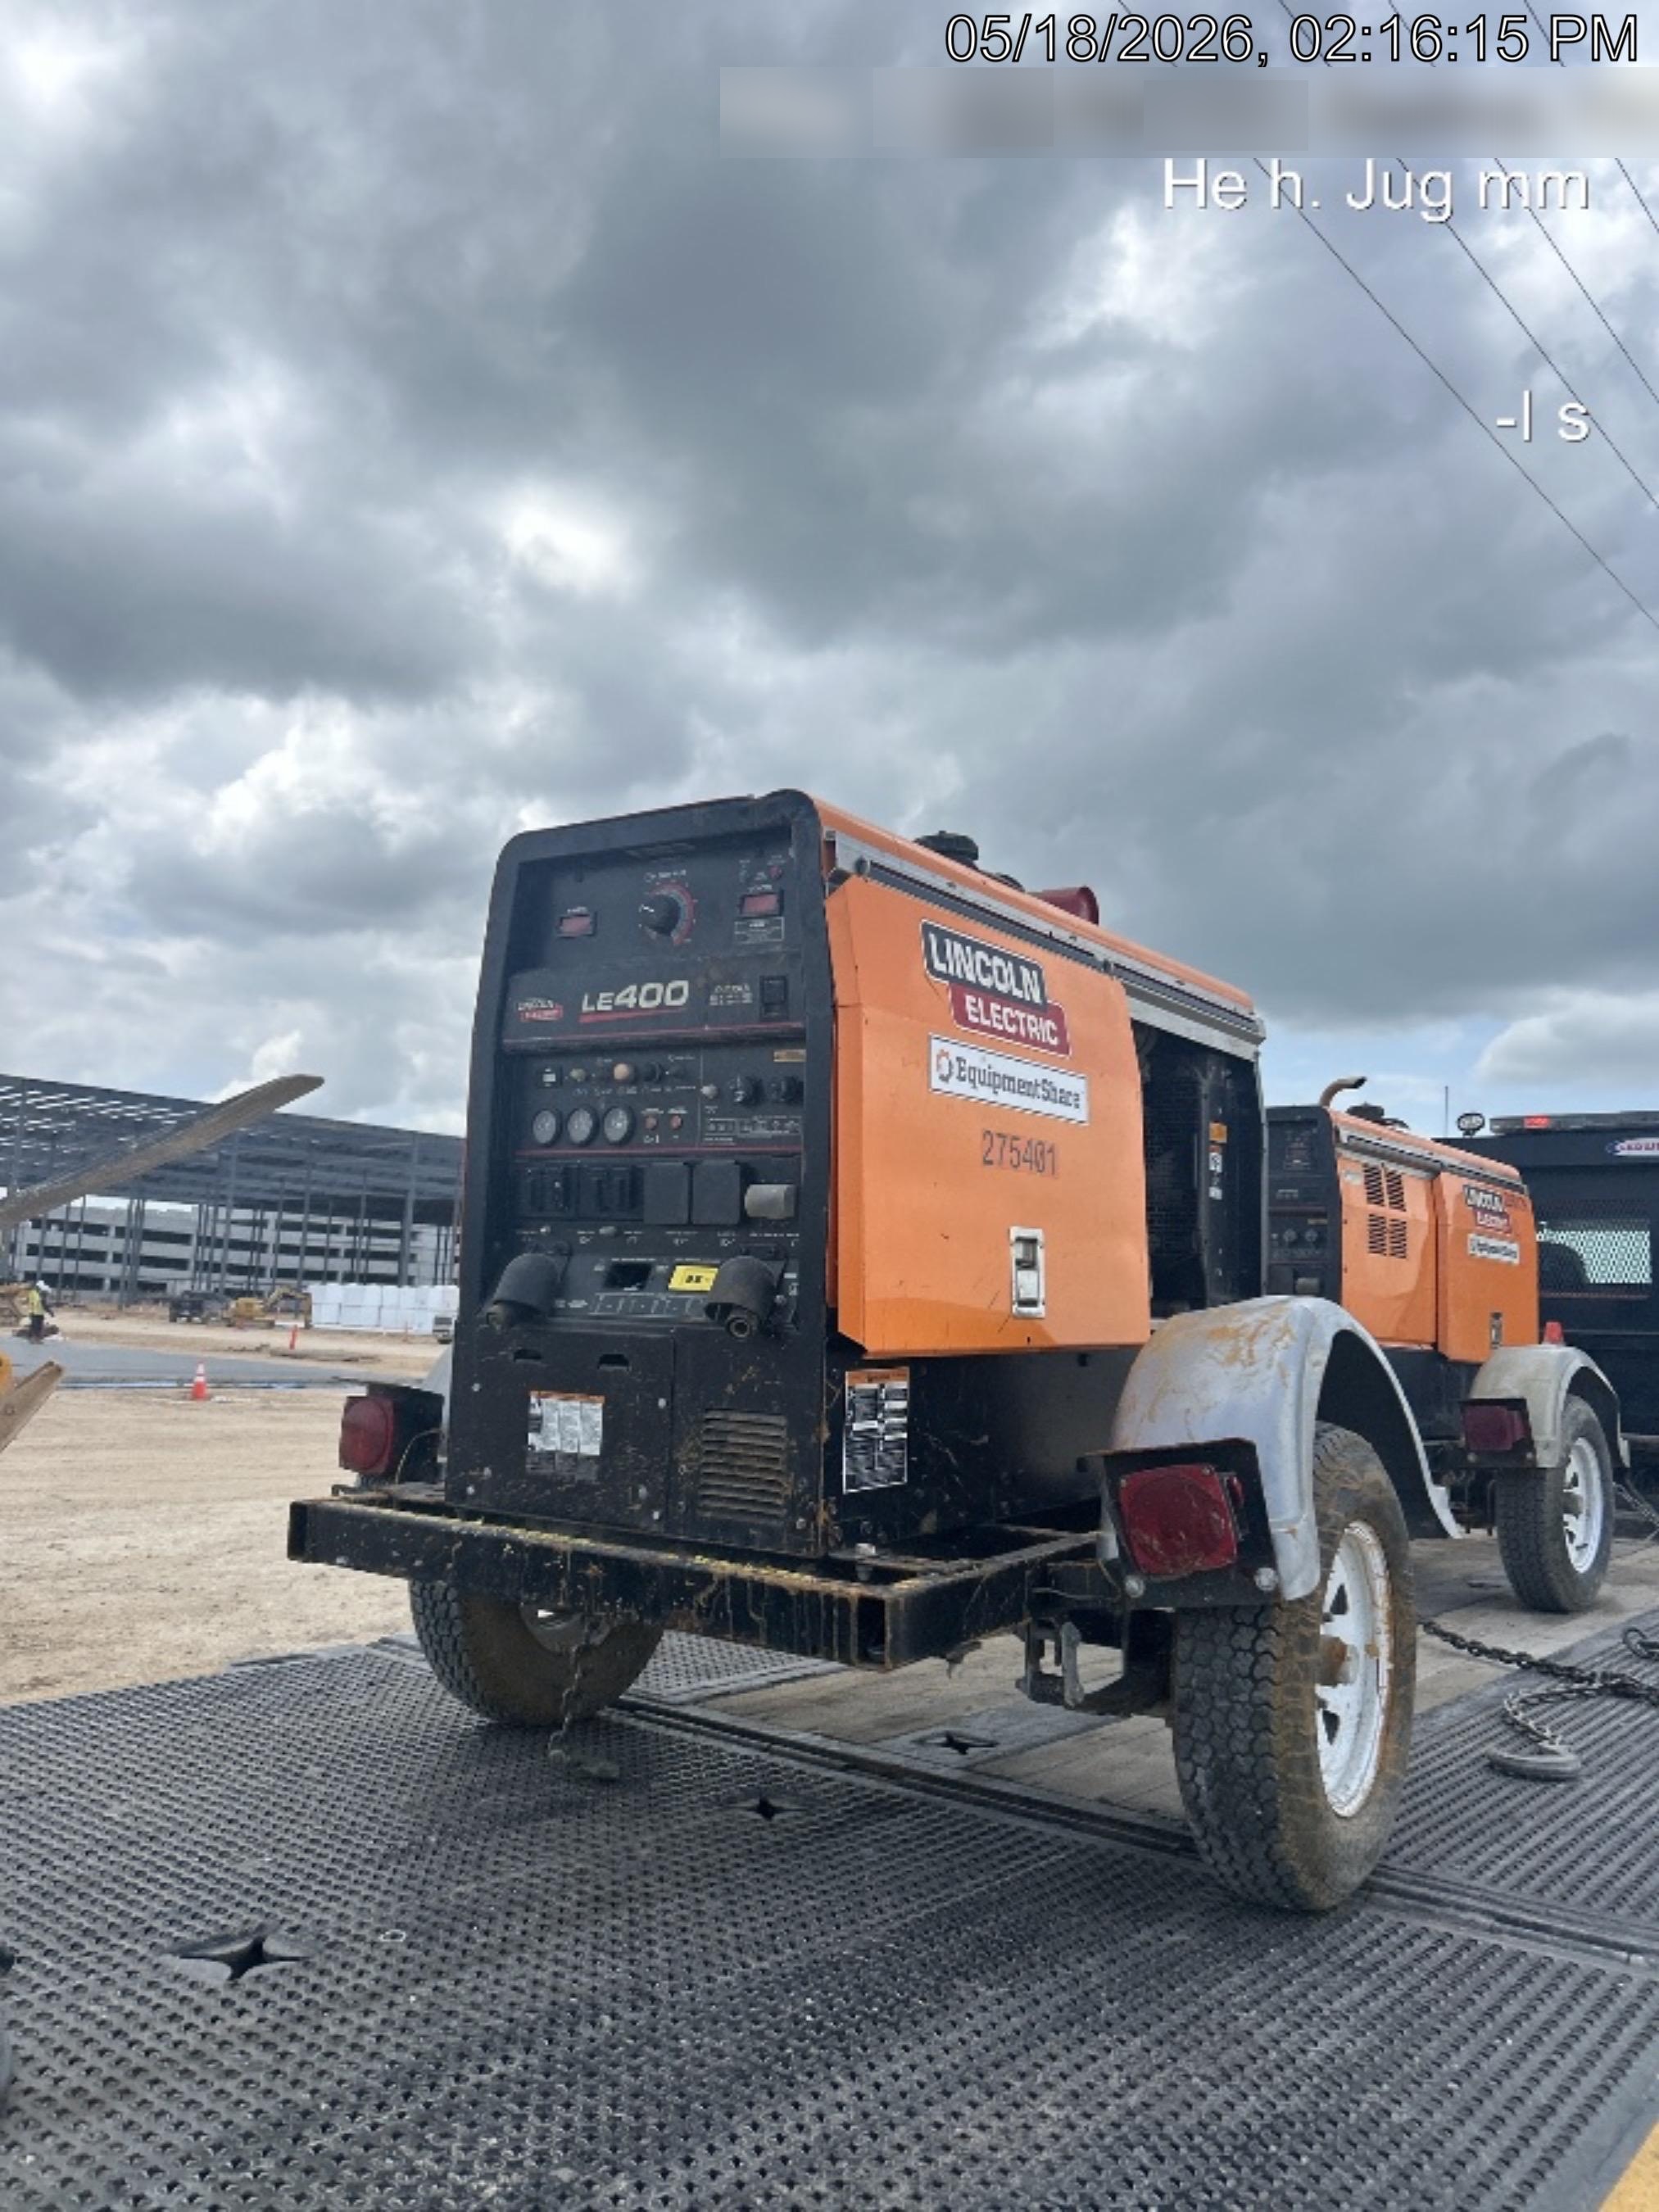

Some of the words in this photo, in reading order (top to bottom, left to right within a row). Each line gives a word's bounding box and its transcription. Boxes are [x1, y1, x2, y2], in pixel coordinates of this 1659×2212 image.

[929, 933, 1041, 1005] LINCOLN
[582, 980, 689, 1013] LE400
[964, 994, 1059, 1046] ELECTRIC
[981, 1129, 1057, 1176] 275401
